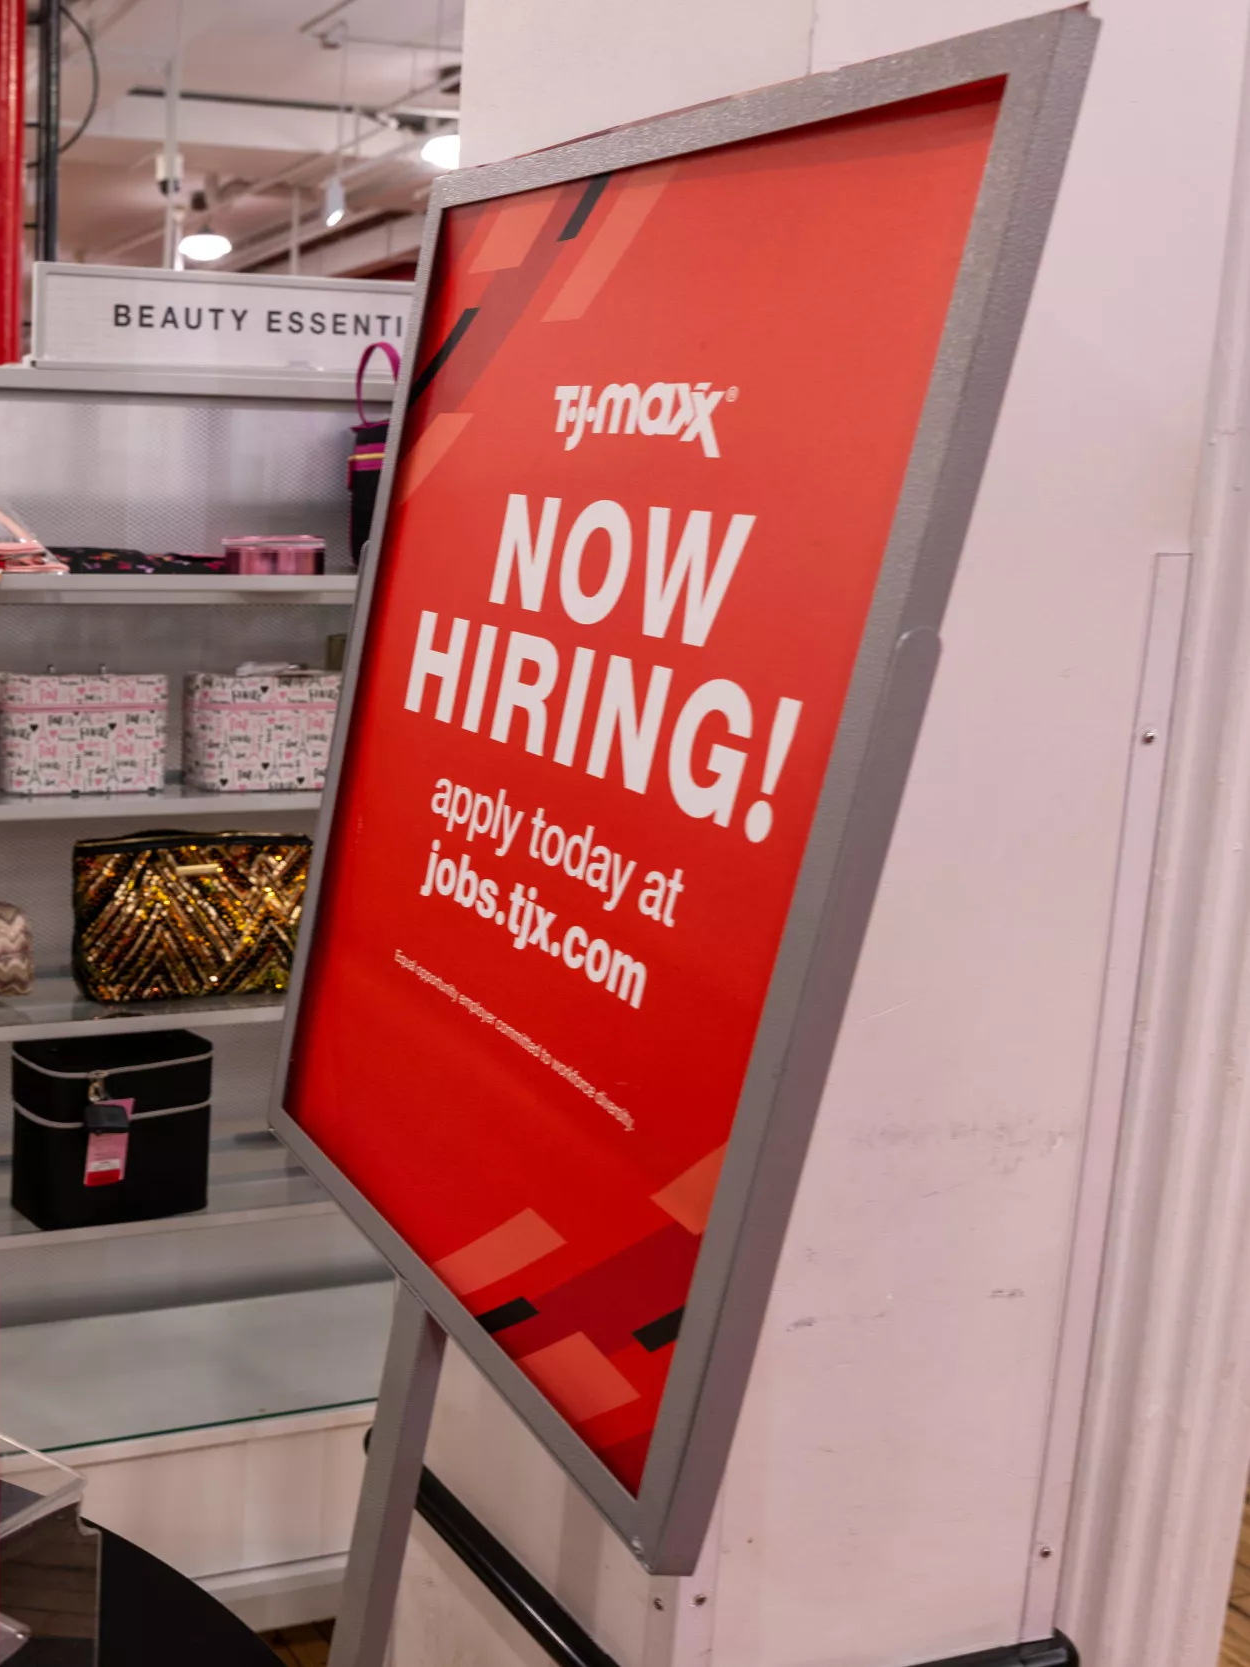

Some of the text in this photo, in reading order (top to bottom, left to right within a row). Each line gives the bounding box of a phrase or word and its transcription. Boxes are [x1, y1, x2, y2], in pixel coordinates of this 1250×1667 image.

[113, 303, 248, 331] BEAUTY
[489, 494, 757, 647] NOW
[404, 610, 803, 843] HIRING!
[420, 839, 647, 1009] jobs.tjx.com
[431, 778, 685, 928] apply today at
